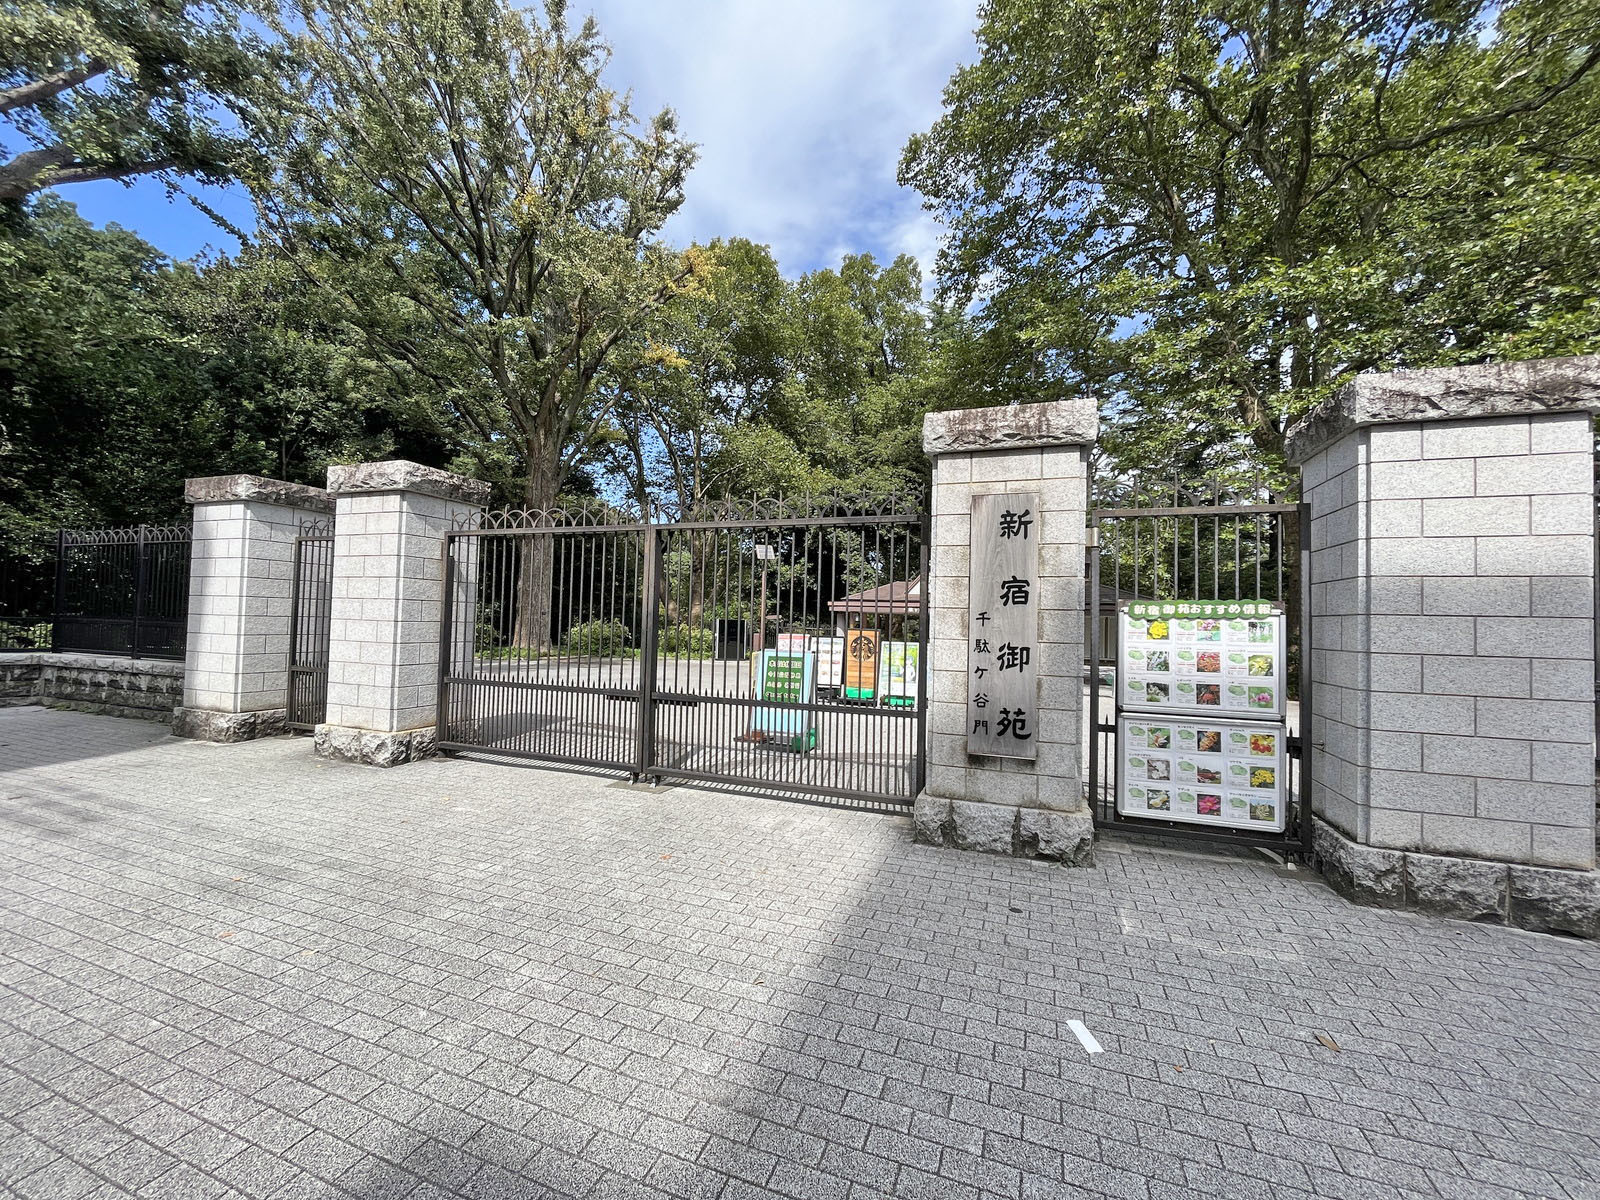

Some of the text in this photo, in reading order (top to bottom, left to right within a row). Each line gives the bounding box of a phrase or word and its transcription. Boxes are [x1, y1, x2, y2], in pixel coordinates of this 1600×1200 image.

[996, 509, 1033, 740] 新宿御苑
[1134, 603, 1271, 615] 新宿御苑おすすめ情報
